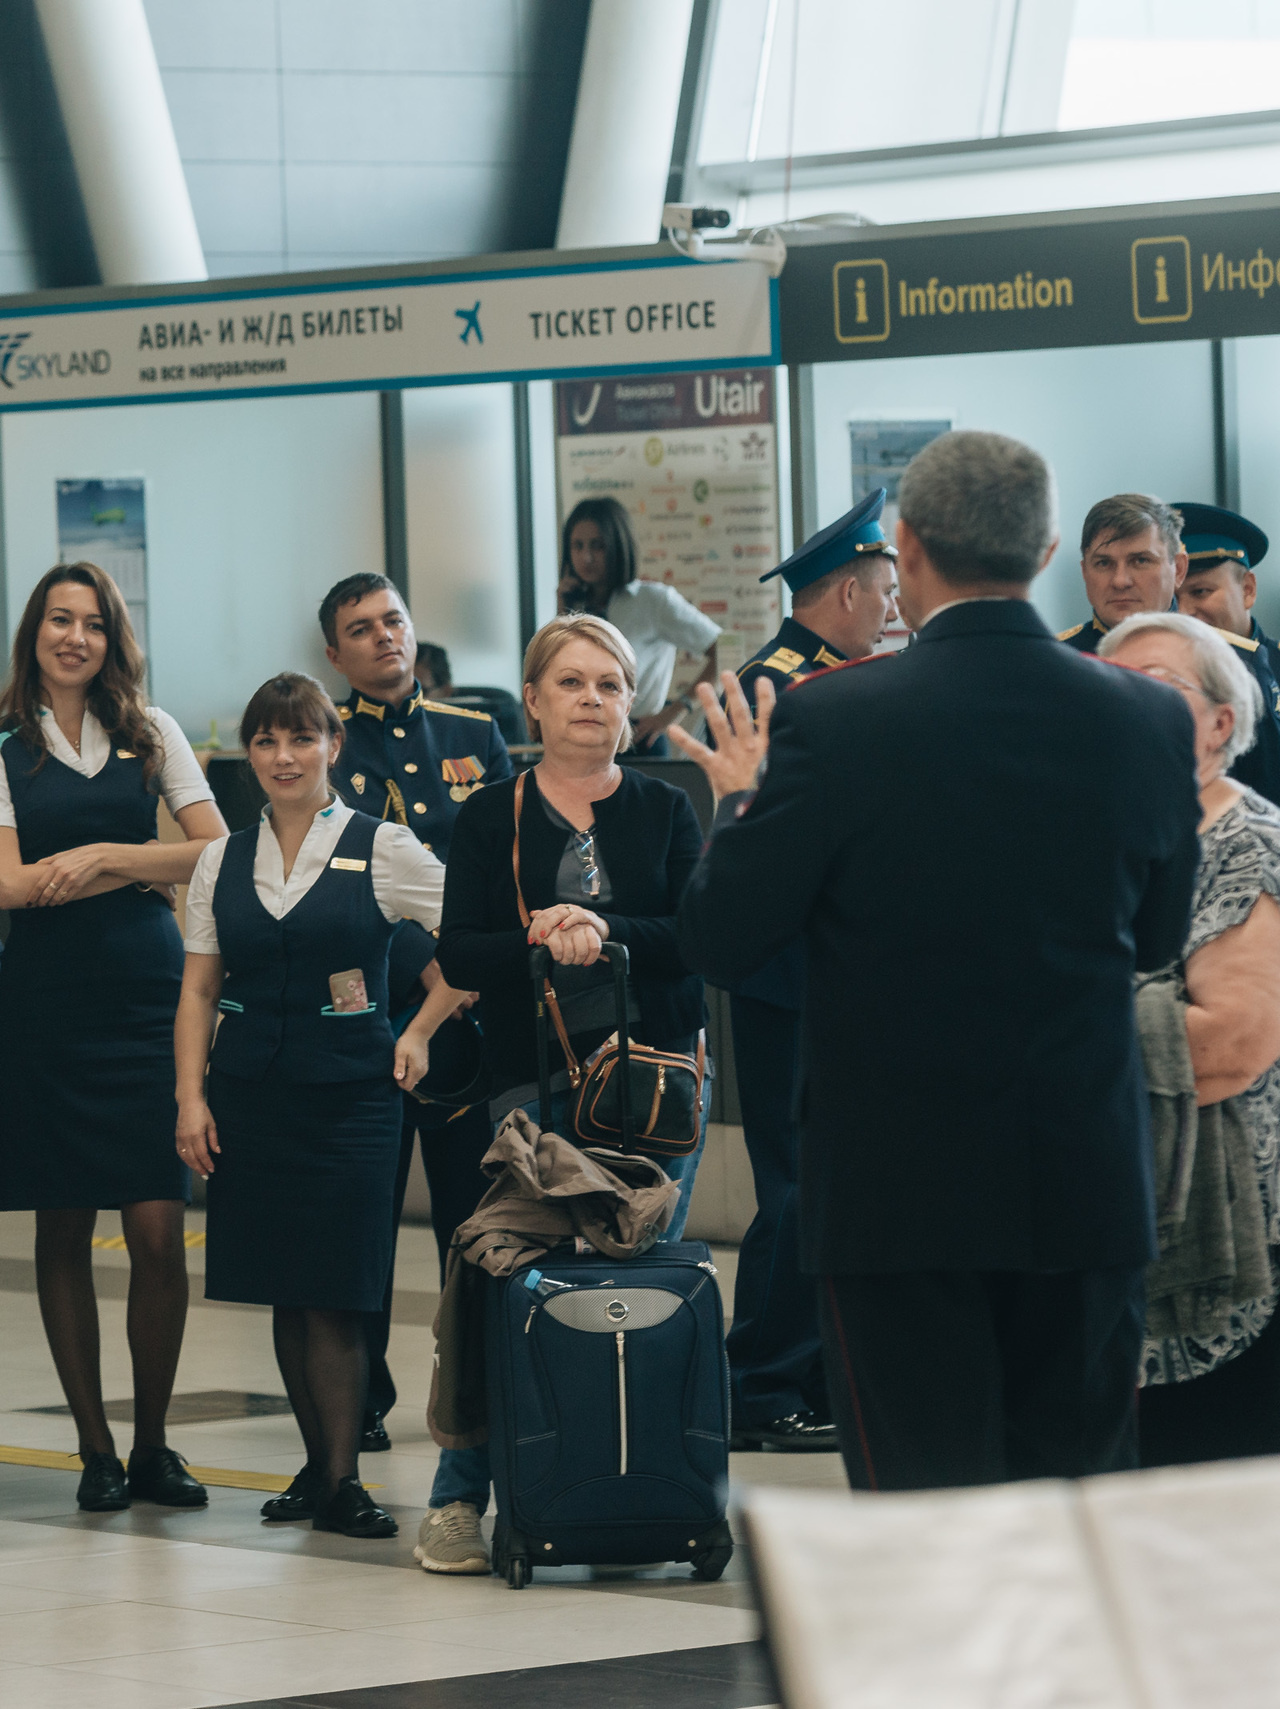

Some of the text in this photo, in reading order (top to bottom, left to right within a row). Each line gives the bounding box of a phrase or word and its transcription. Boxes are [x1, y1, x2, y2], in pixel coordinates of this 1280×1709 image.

[898, 270, 1073, 317] Information
[1202, 247, 1280, 299] Инф
[138, 304, 403, 350] АВИА- И Ж/Д БИЛЕТЫ
[529, 300, 716, 340] TICKET OFFICE
[17, 349, 112, 381] SKYLAND
[693, 371, 766, 419] Utair
